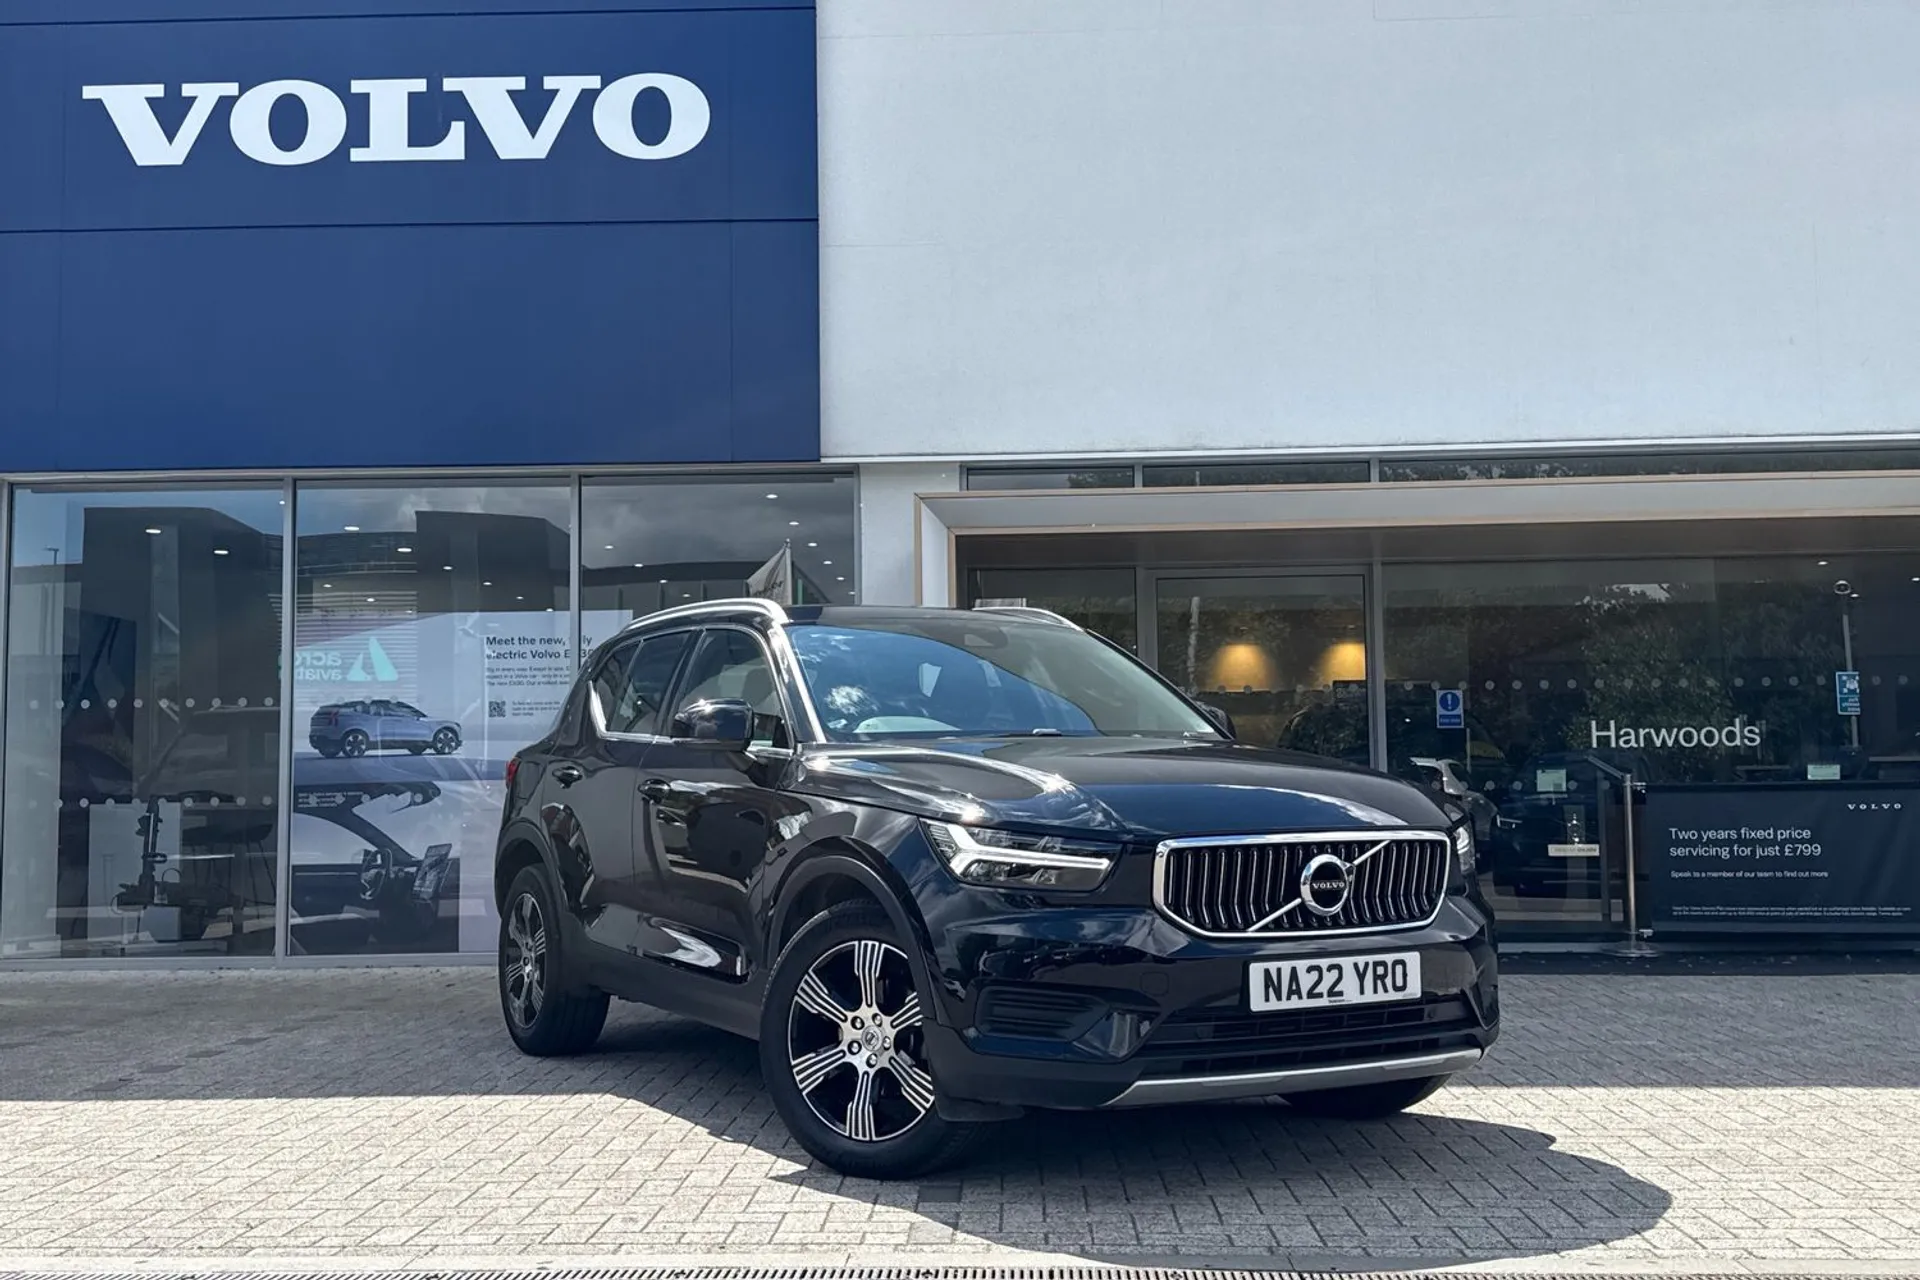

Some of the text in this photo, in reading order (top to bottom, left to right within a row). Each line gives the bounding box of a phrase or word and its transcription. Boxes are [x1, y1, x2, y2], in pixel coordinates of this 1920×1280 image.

[82, 72, 710, 166] VOLVO
[486, 636, 566, 647] Meet the new,
[530, 649, 560, 660] Volvo
[1590, 717, 1761, 749] Harwoods
[1847, 802, 1902, 810] VOLVO
[1669, 826, 1812, 842] Two years fixed price
[1669, 843, 1822, 860] servicing for just £799
[1670, 870, 1692, 879] Speak
[1707, 870, 1734, 878] member
[1736, 870, 1743, 878] of
[1783, 870, 1797, 878] find
[1312, 881, 1345, 890] VOLVO
[1263, 958, 1408, 1003] NA22 YRO
